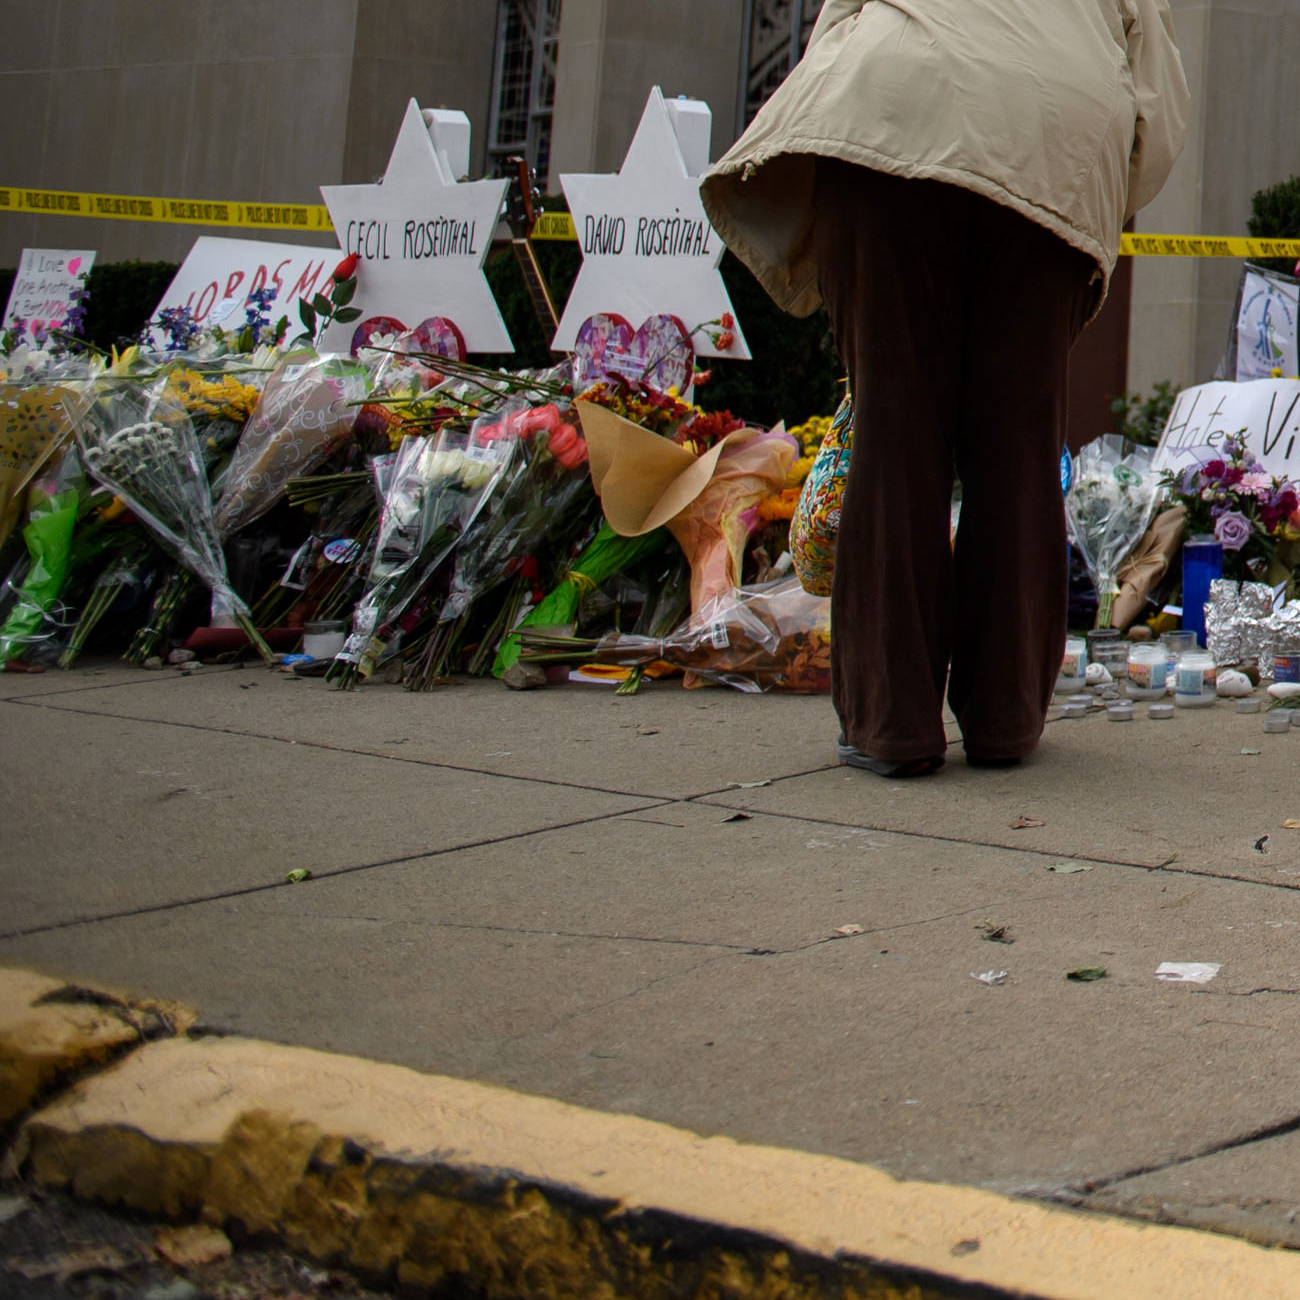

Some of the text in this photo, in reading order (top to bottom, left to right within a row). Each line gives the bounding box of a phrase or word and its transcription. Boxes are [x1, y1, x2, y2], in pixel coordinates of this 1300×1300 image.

[347, 218, 477, 259] CECIL ROSENTHAL
[583, 214, 711, 257] DAVID ROSENTHAL
[1156, 389, 1227, 463] Hate
